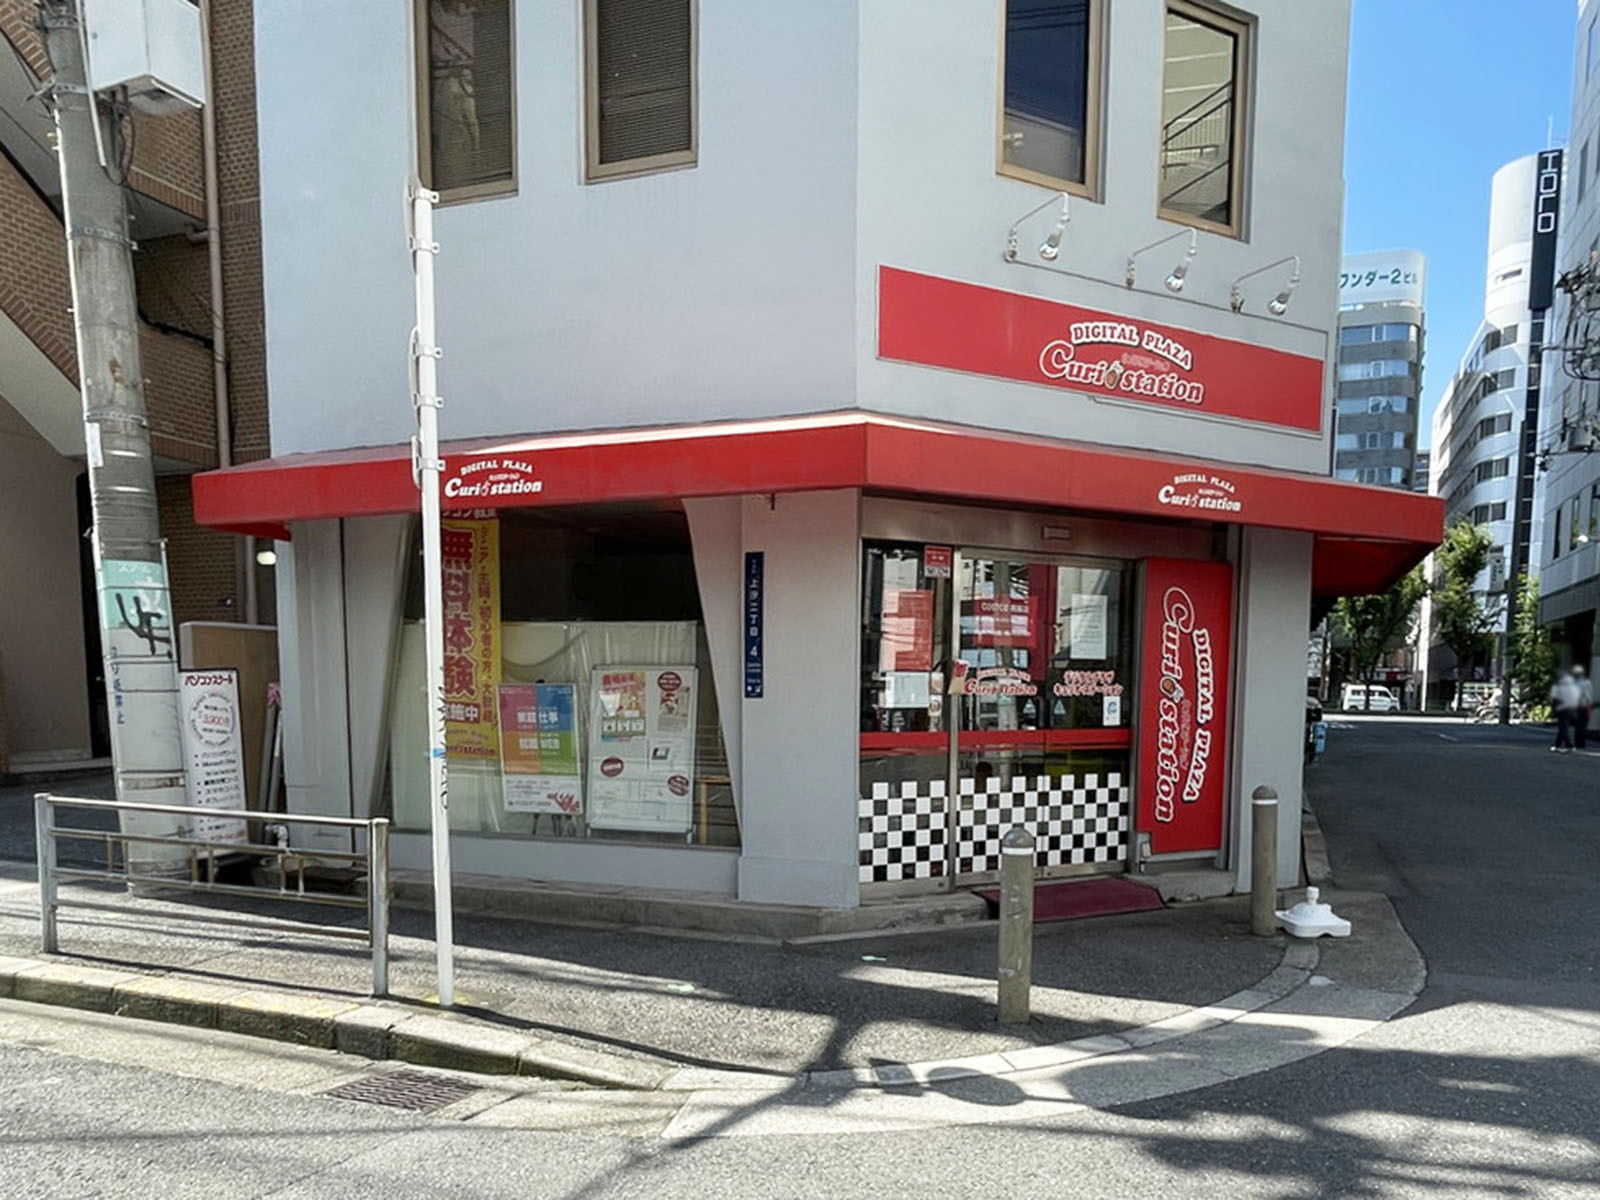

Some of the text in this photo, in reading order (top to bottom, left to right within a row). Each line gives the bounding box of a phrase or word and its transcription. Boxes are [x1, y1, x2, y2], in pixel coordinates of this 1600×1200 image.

[1070, 322, 1139, 347] DIGITAL
[1142, 330, 1193, 371] PLAZA
[460, 459, 533, 476] DIGITAL PLAZA
[1174, 473, 1208, 485] DIGITAL
[1210, 476, 1235, 494] PLAZA
[184, 674, 233, 686] パソコンスクール
[1193, 628, 1213, 724] DIGITAL
[1183, 730, 1211, 802] PLAZA
